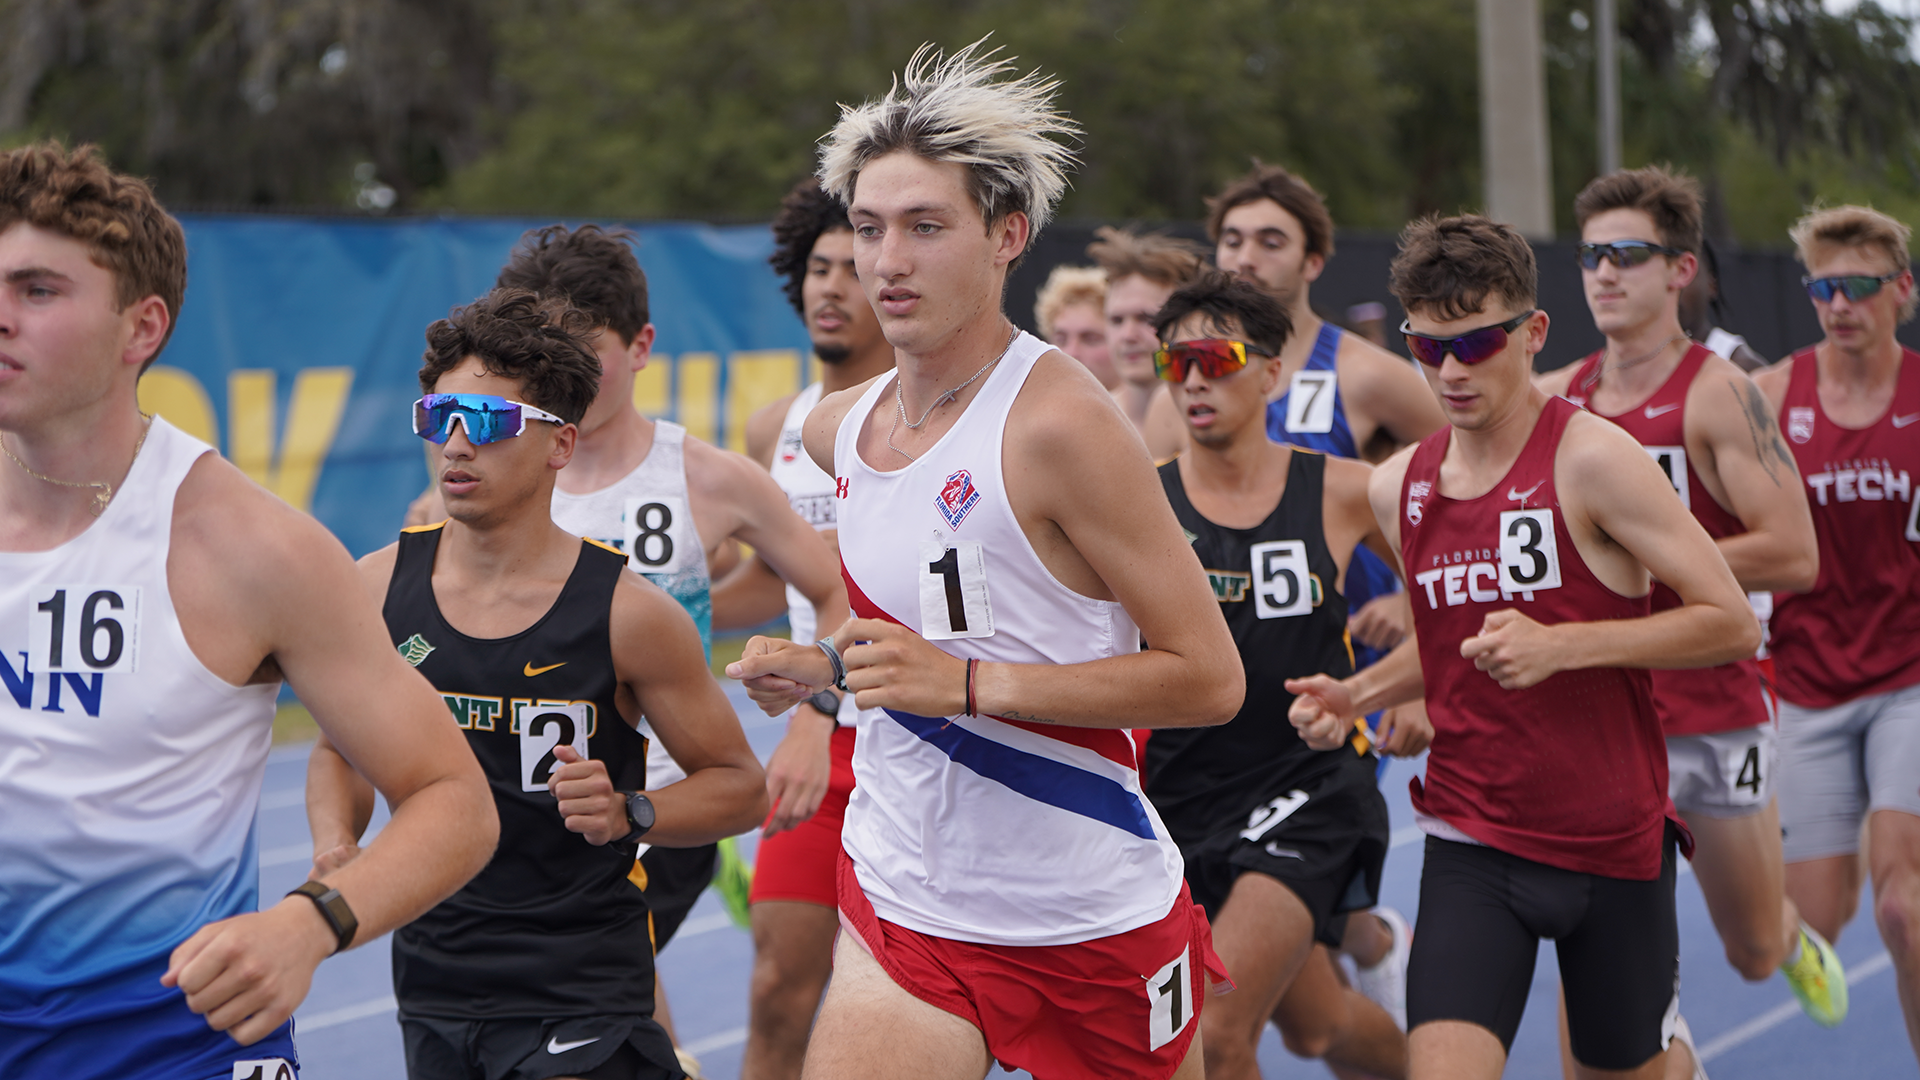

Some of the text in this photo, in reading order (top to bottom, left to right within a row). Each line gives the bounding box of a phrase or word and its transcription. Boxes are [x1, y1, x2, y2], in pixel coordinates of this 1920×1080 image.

[1299, 379, 1327, 424] 7
[935, 491, 980, 528] FLORIDA SOUTHERN
[1807, 468, 1910, 506] TECH
[634, 502, 673, 566] 8
[1507, 516, 1548, 585] 3
[929, 547, 968, 632] 1
[1262, 549, 1299, 609] 5
[37, 589, 125, 670] 16
[529, 712, 576, 785] 2
[1736, 746, 1762, 794] 4
[1158, 961, 1182, 1034] 1
